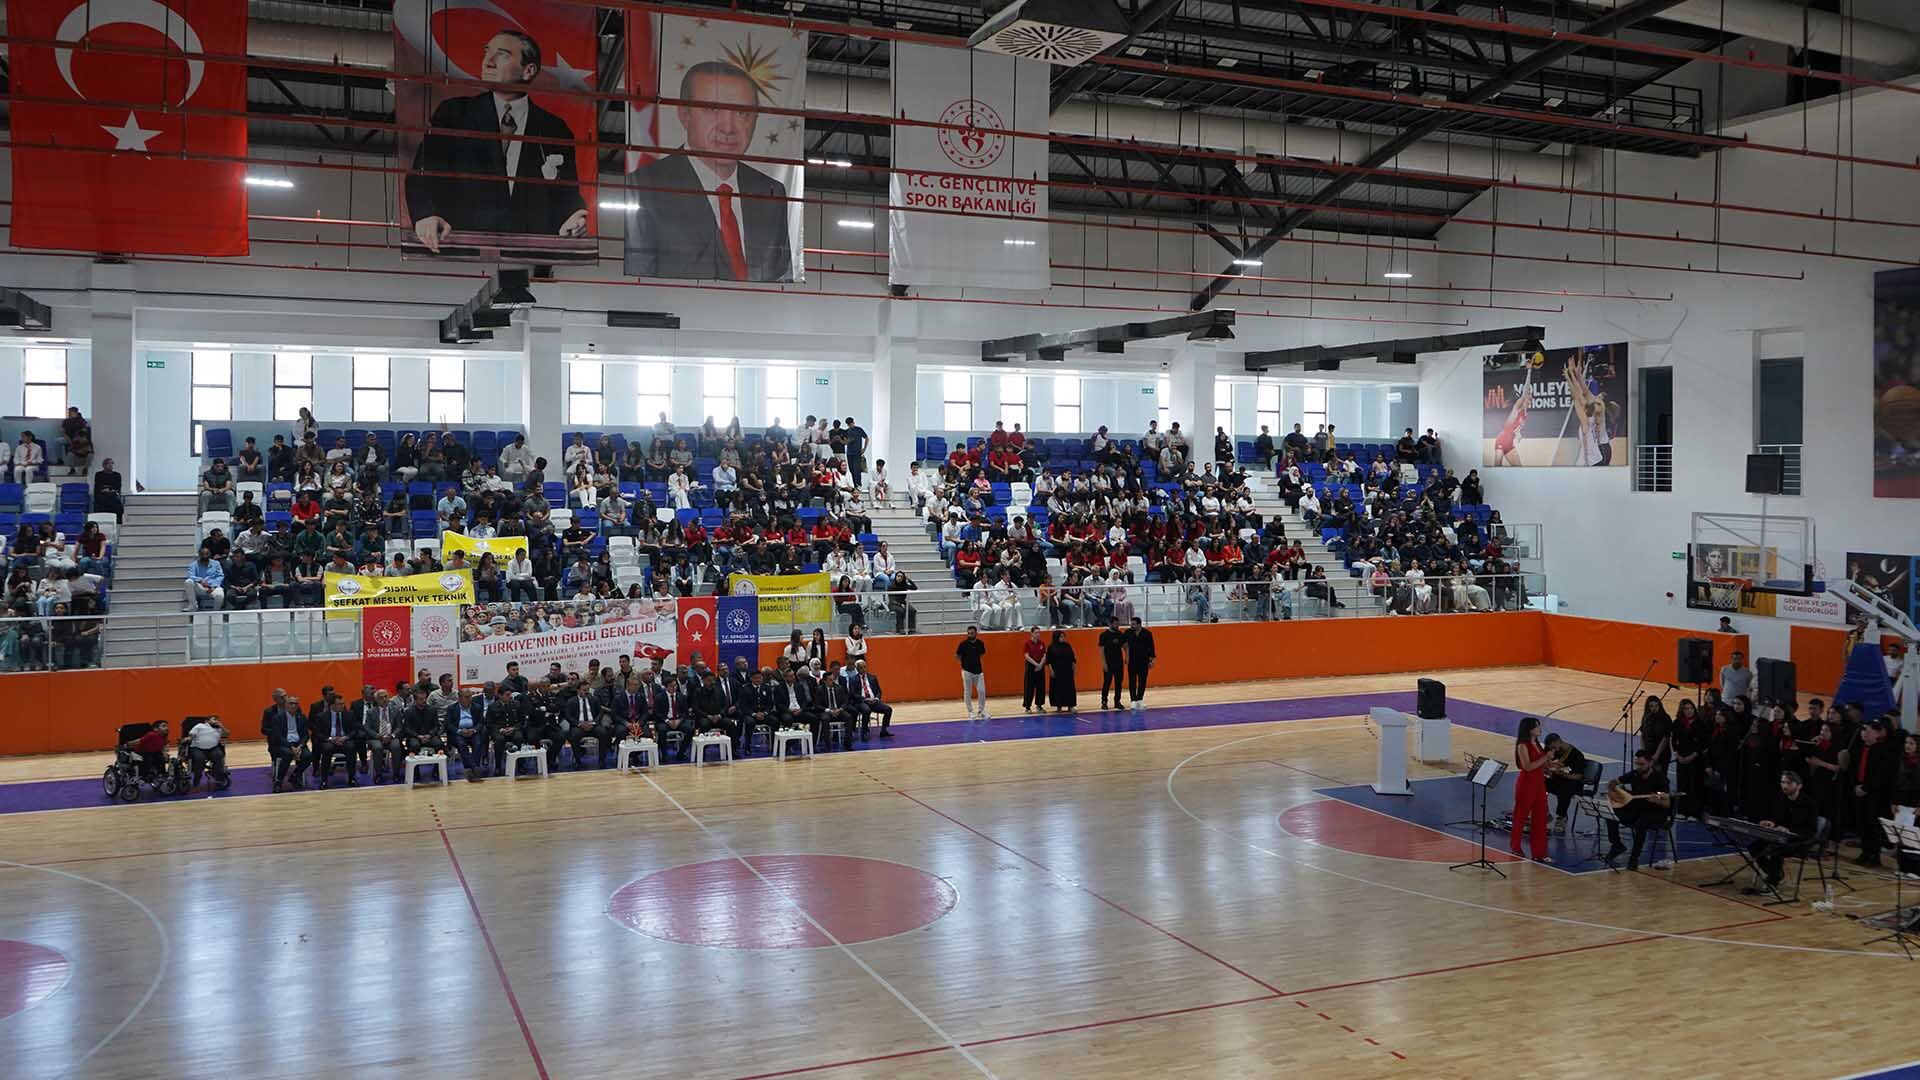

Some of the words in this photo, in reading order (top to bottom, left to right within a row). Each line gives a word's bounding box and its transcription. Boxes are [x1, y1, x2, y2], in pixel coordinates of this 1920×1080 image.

[906, 173, 935, 189] T.C.
[1016, 182, 1037, 196] VE
[906, 192, 947, 208] SPOR
[952, 196, 1036, 214] BAKANLIĞI
[333, 598, 372, 607] ŞEFKAT
[373, 595, 415, 605] MESLEKİ
[417, 595, 430, 603] VE
[432, 592, 467, 603] TEKNİK
